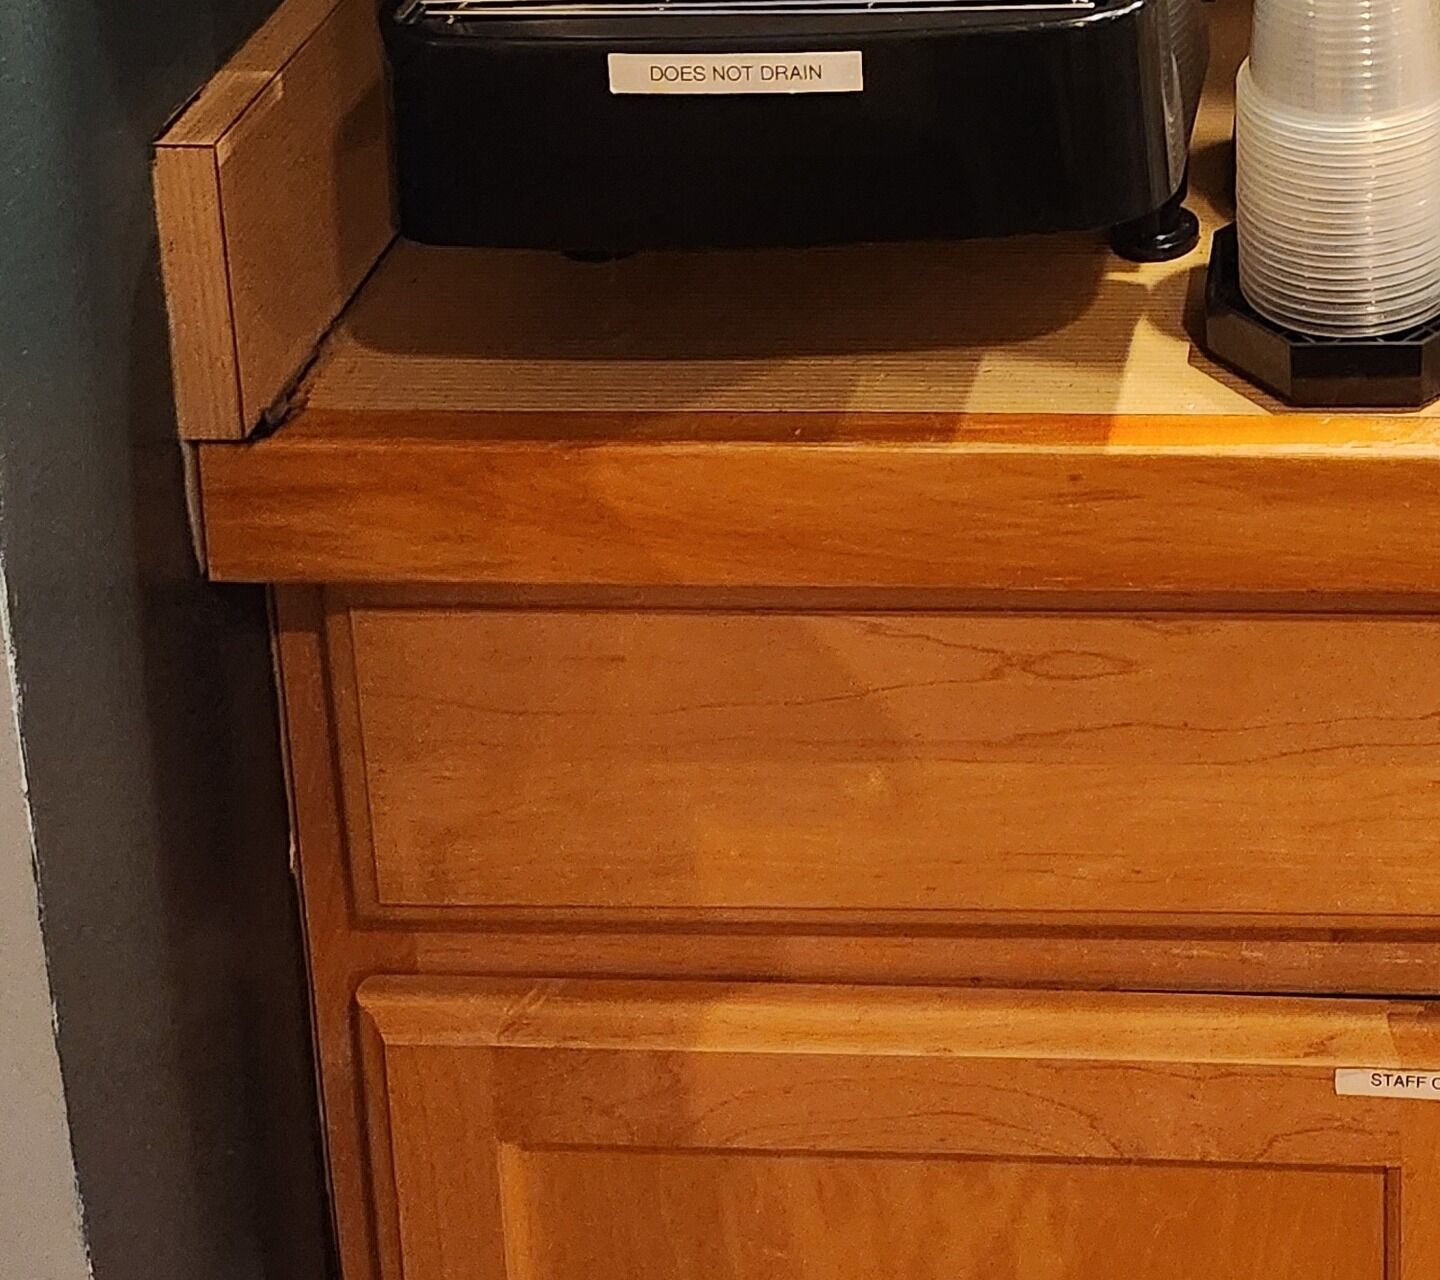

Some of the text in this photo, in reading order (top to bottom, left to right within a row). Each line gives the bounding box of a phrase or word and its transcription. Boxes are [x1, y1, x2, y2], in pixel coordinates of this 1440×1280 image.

[649, 64, 822, 82] DOES NOT DRAIN
[1370, 1072, 1427, 1088] STAFF
